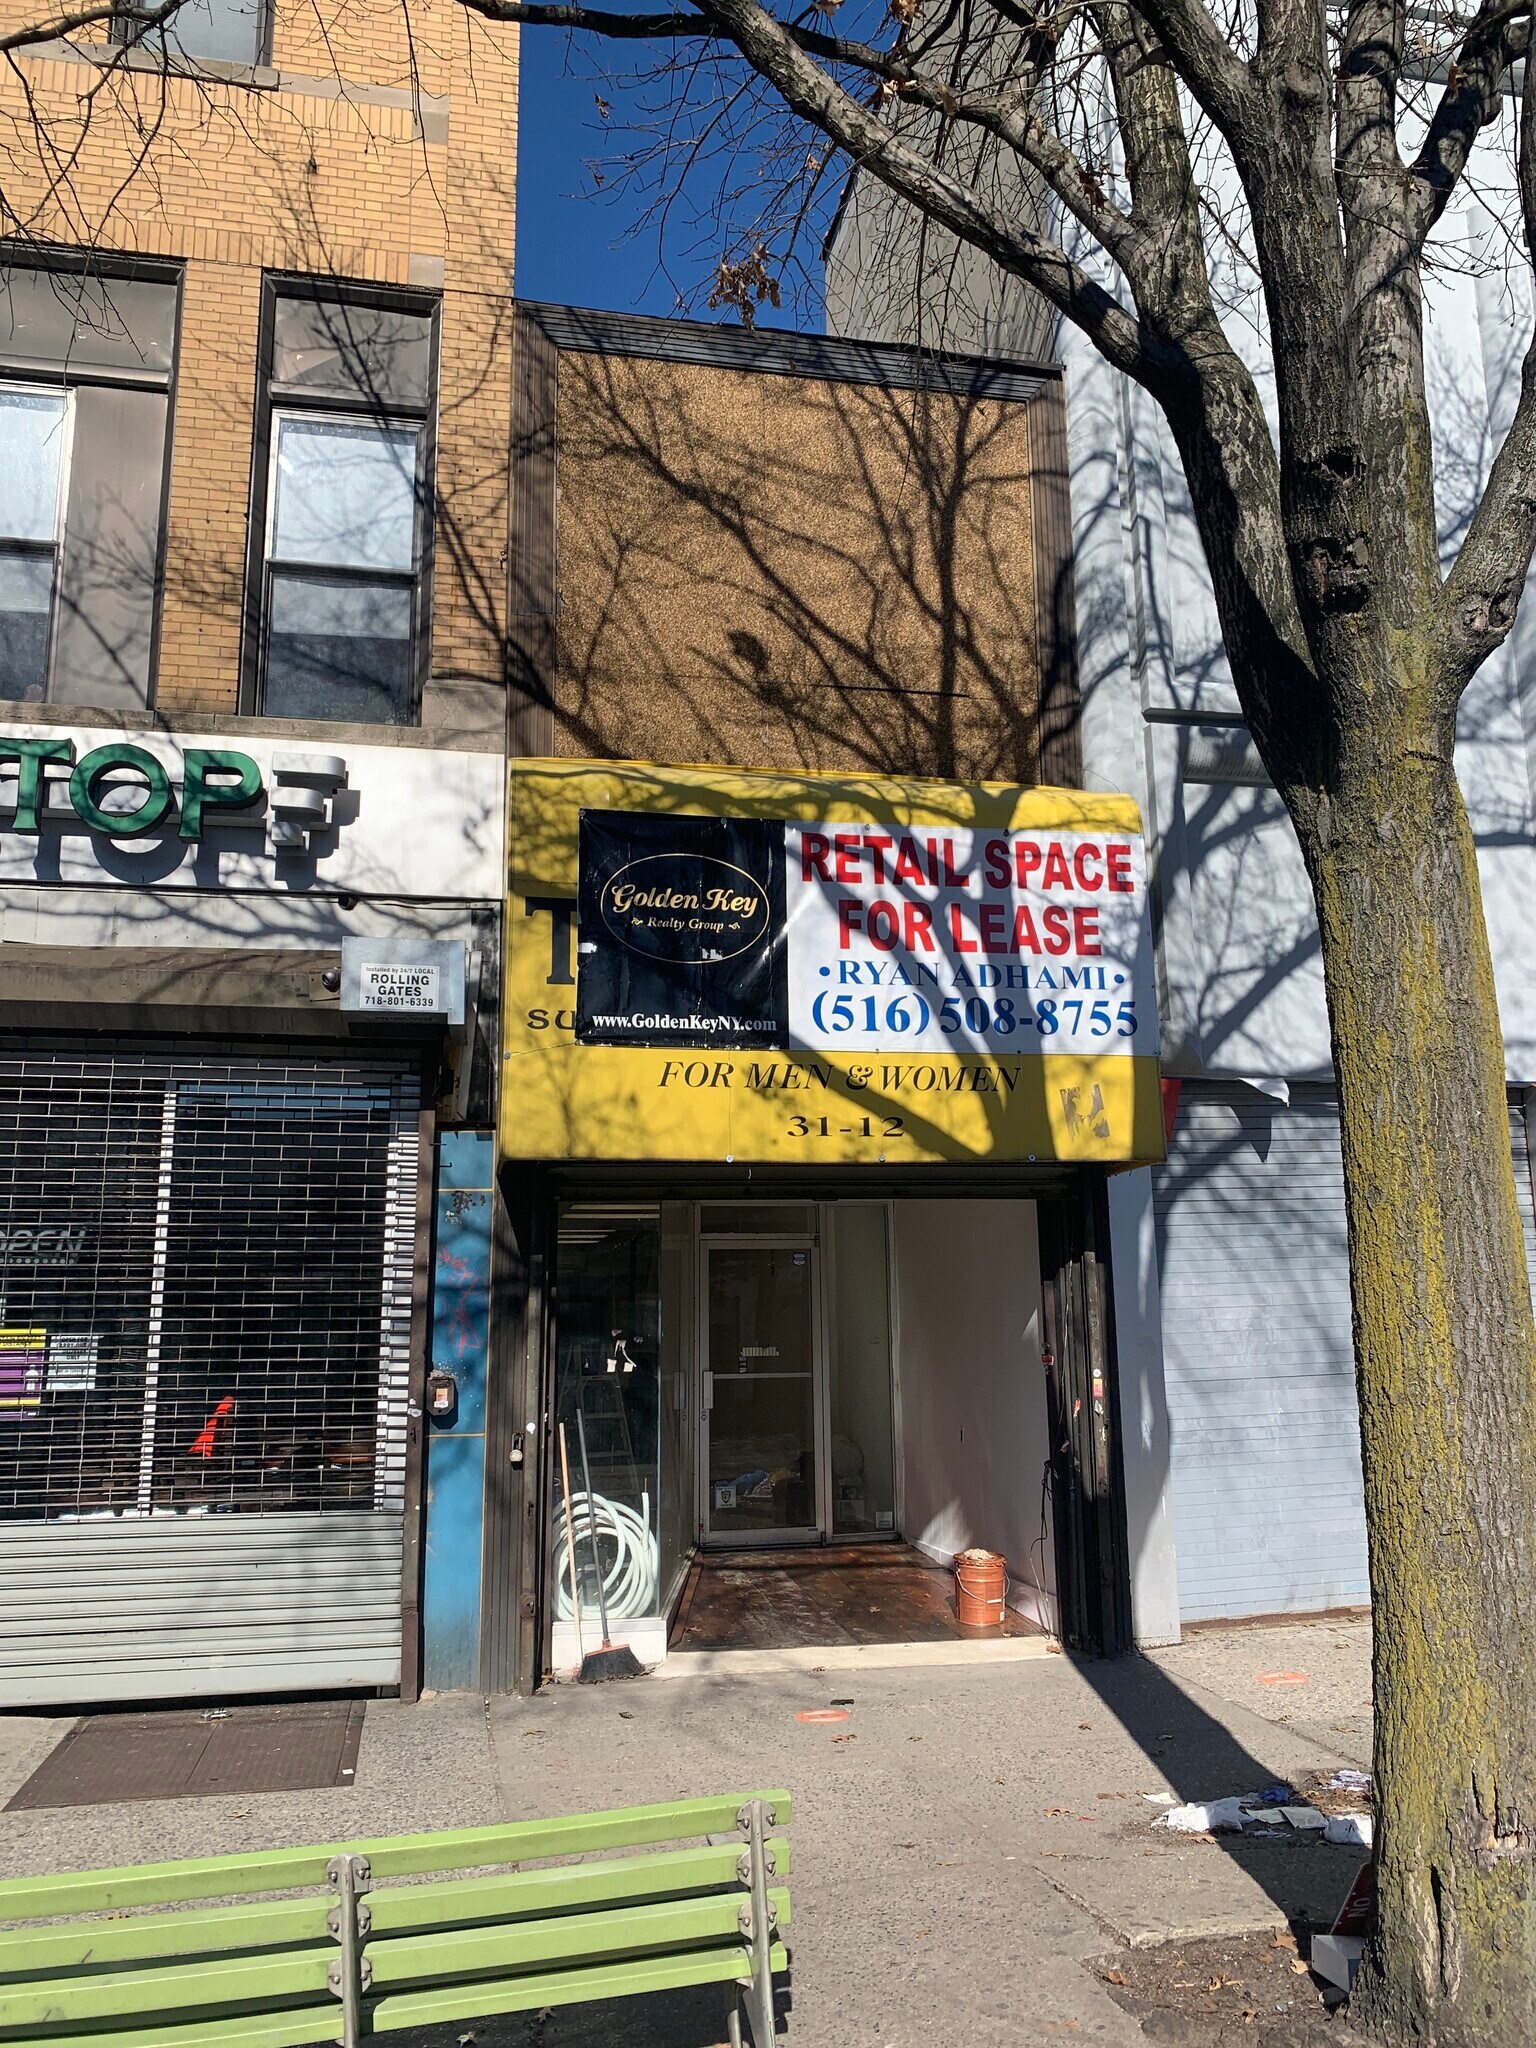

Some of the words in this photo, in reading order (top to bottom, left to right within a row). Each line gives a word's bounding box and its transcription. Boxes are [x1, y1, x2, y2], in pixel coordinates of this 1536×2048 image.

[800, 831, 970, 888] RETAIL
[984, 839, 1135, 893] SPACE
[610, 884, 699, 913] Golden
[702, 888, 758, 918] Key
[647, 916, 685, 931] Realty
[688, 918, 724, 934] Group
[838, 898, 936, 952] FOR
[952, 902, 1102, 956] LEASE
[370, 974, 430, 985] ROLLING
[837, 960, 941, 987] RYAN
[949, 963, 1108, 990] ADHAMI
[365, 996, 434, 1007] 718-801-6339
[378, 985, 422, 996] GATES
[592, 1013, 777, 1033] www.GoldenKeyNY.com
[657, 1060, 734, 1089] FOR
[744, 1062, 834, 1091] MEN
[845, 1066, 874, 1091] &
[880, 1065, 1022, 1093] WOMEN
[786, 1114, 906, 1139] 31-12
[0, 1229, 86, 1257] PEN
